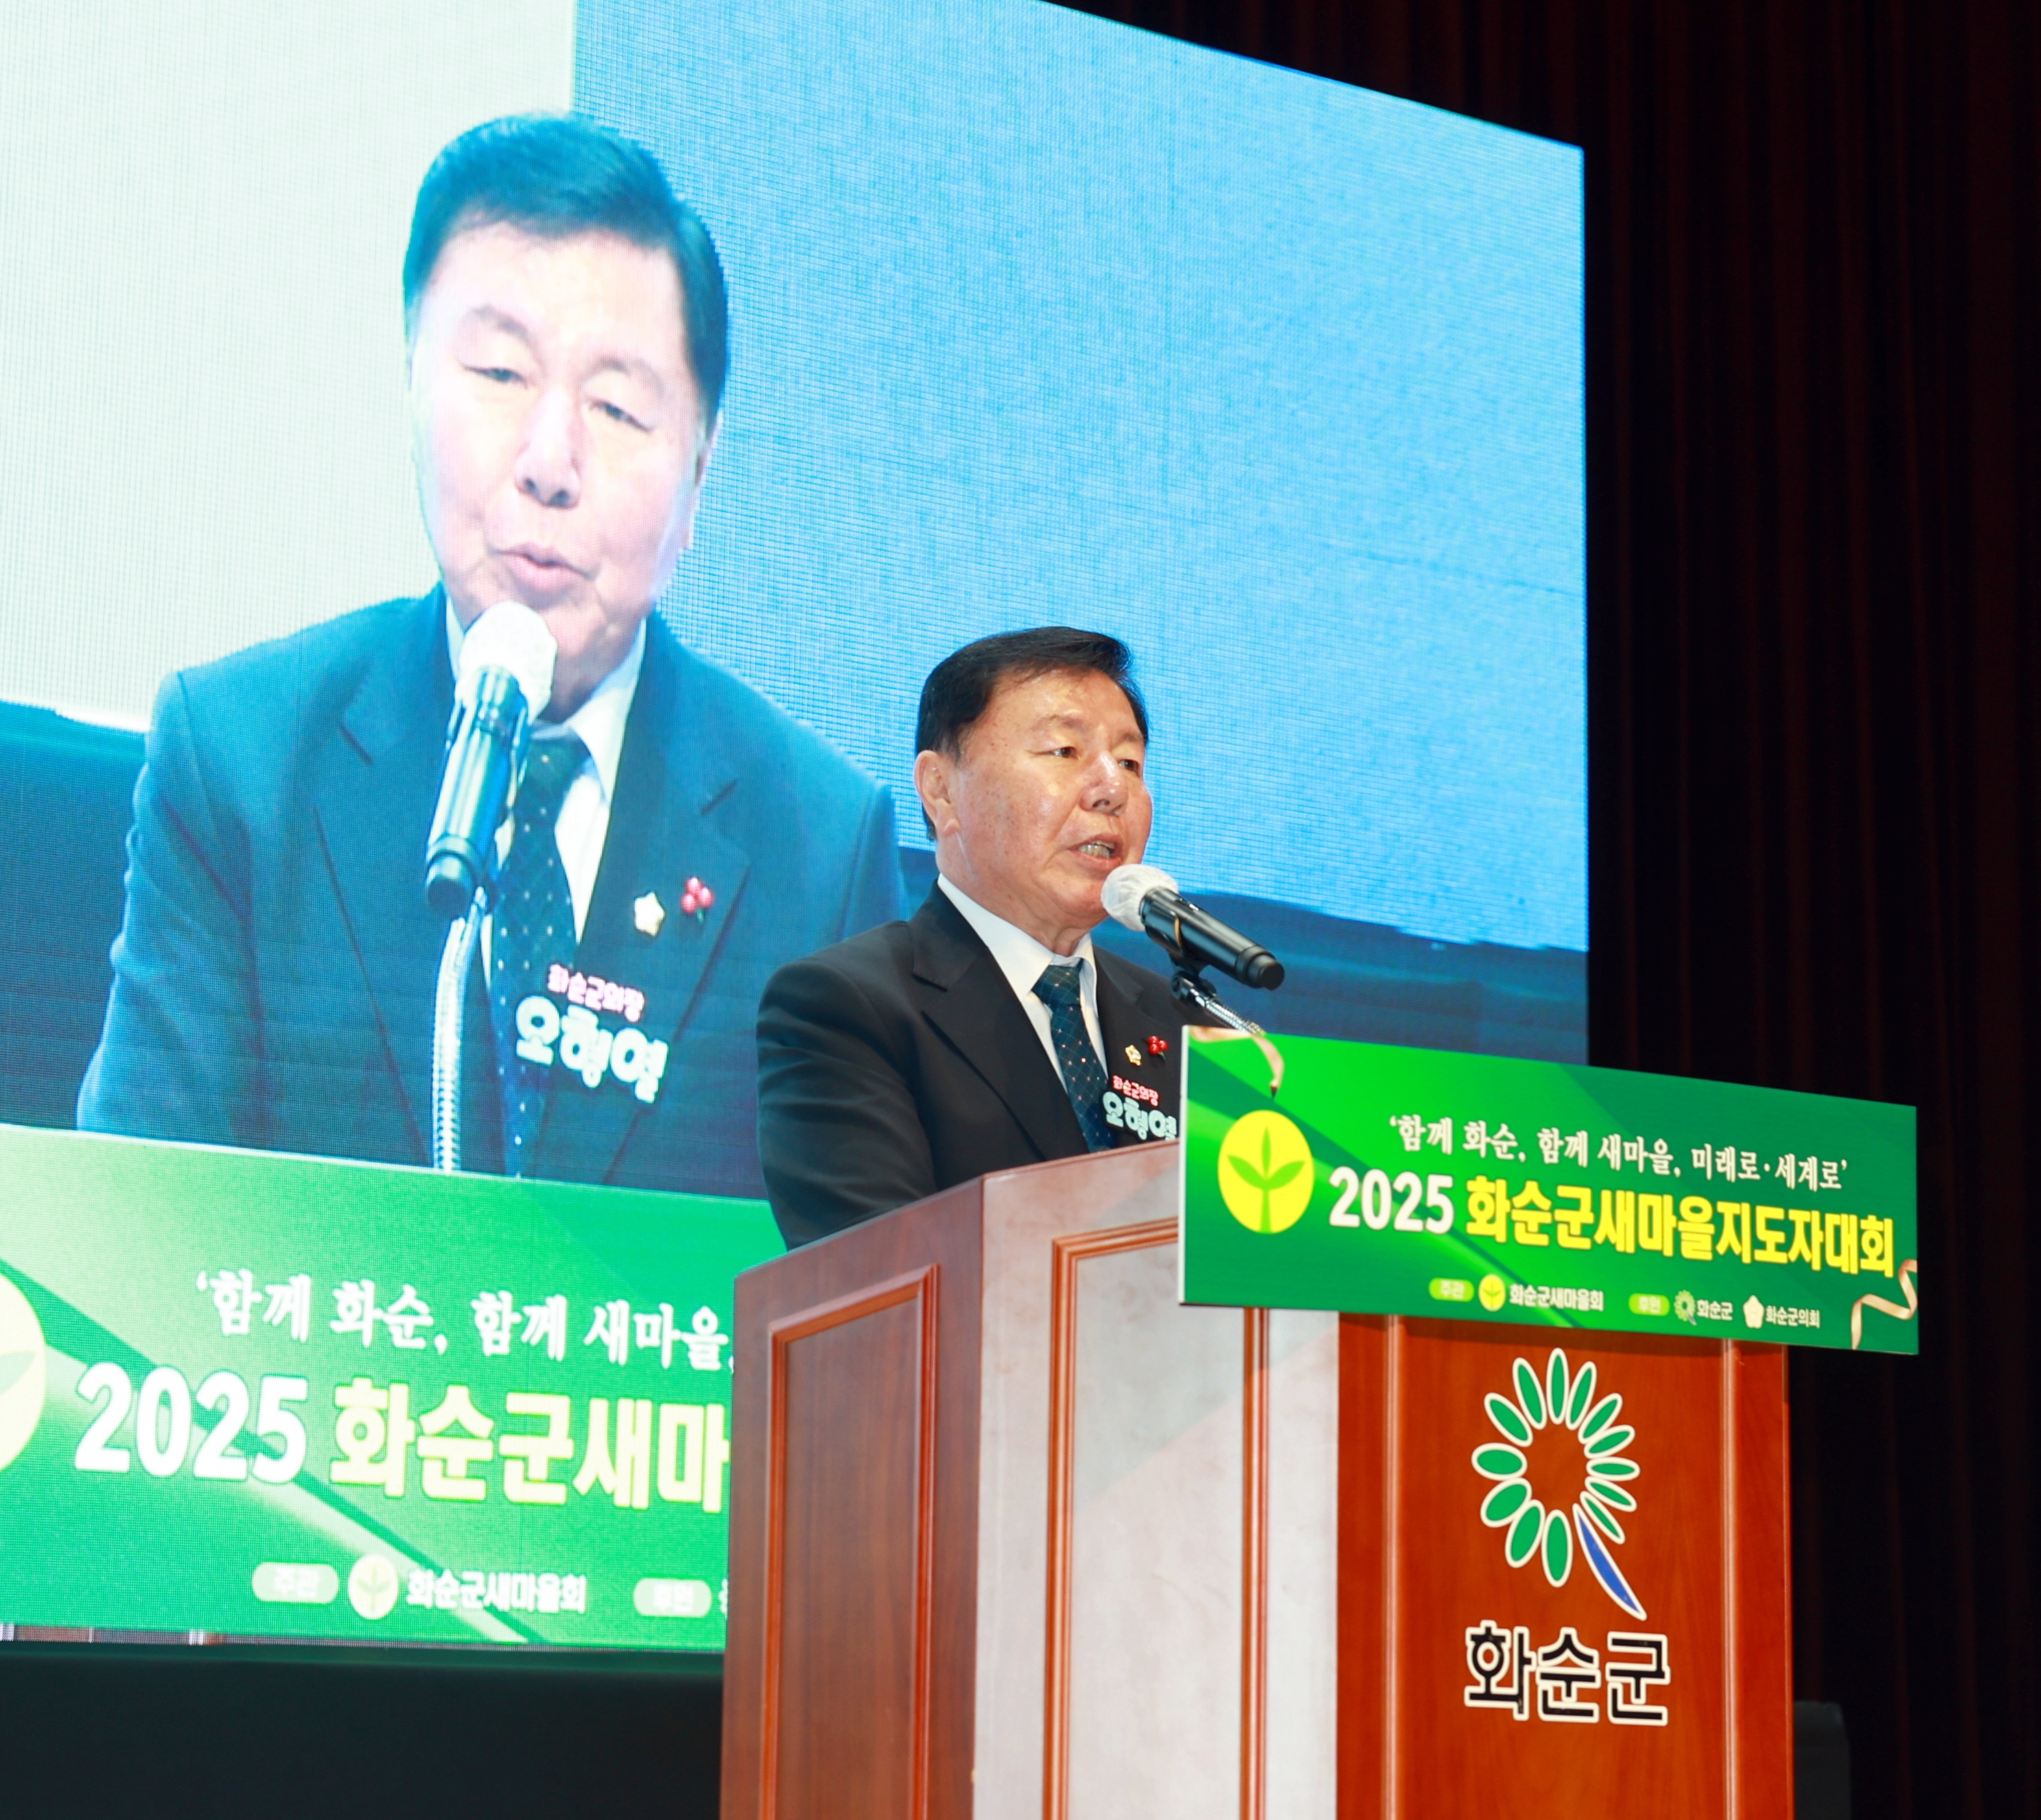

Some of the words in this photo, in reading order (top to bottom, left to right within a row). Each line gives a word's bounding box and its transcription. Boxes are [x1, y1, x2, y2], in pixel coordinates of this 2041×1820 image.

[1112, 1075, 1159, 1107] 화순군의장
[1462, 1120, 1526, 1163] 화순,
[1536, 1127, 1589, 1168] 함께
[1596, 1133, 1681, 1178] 새마을,
[1328, 1166, 1455, 1235] 2025
[1465, 1175, 1894, 1278] 화순군새마을지도자대회
[329, 1279, 448, 1356] 화순,
[470, 1289, 567, 1362] 함께
[1509, 1283, 1604, 1312] 화순군새마을회
[1696, 1299, 1733, 1321] 화순군
[1765, 1305, 1820, 1329] 화순군의회
[74, 1362, 309, 1484] 2025
[406, 1568, 587, 1615] 화순군새마을회
[1465, 1621, 1670, 1725] 화순군
